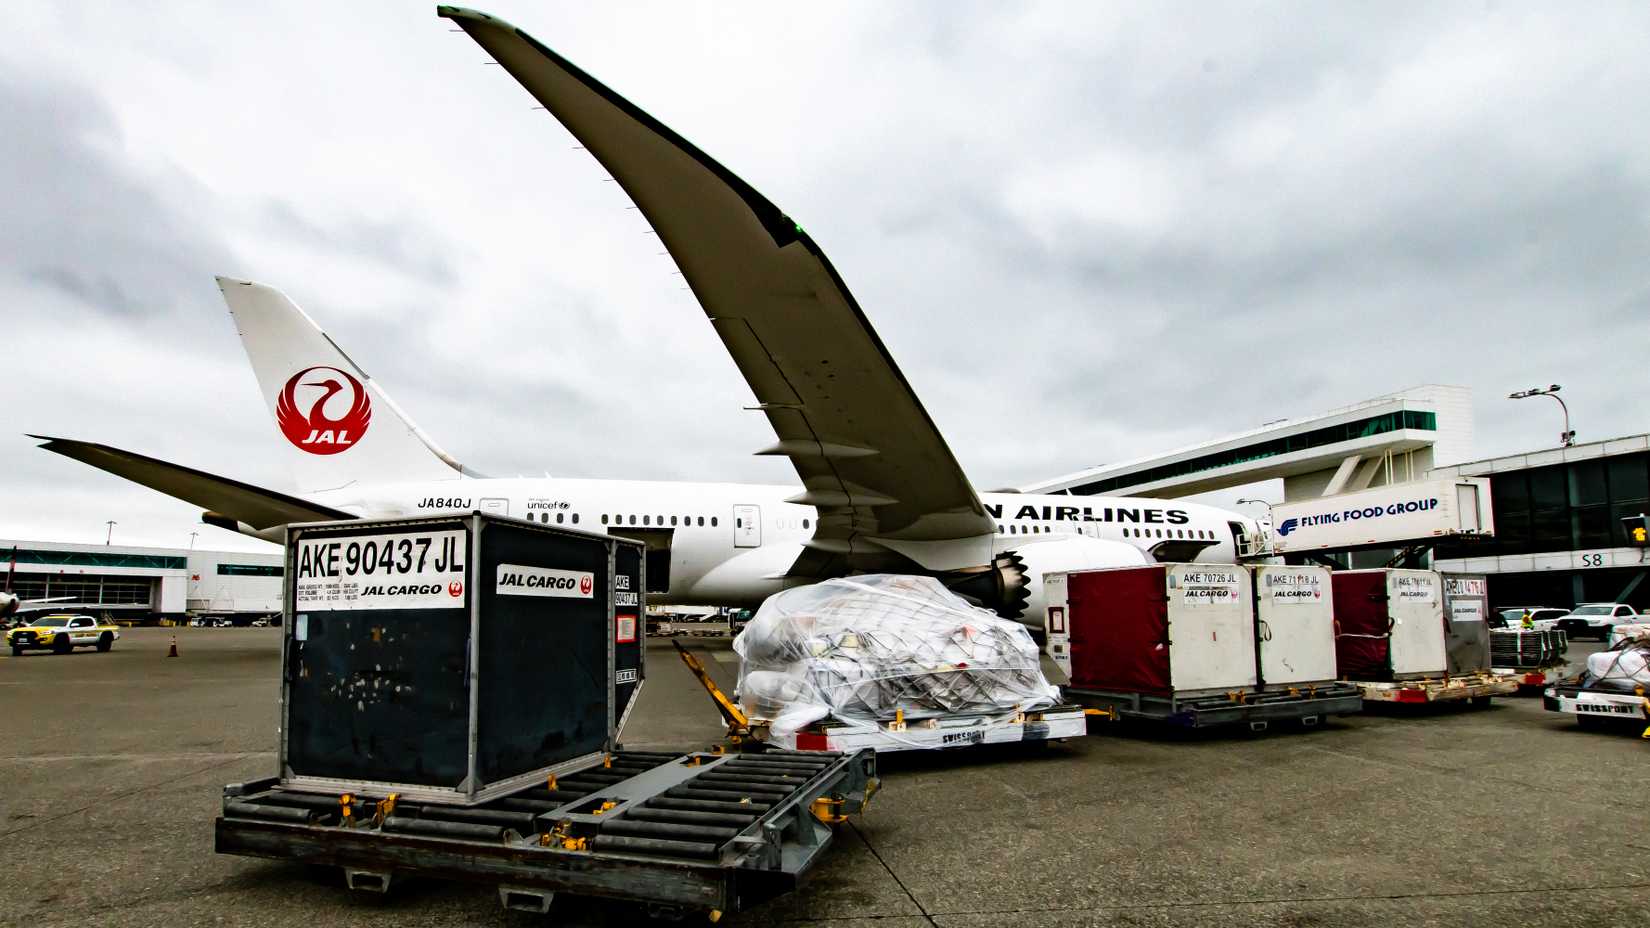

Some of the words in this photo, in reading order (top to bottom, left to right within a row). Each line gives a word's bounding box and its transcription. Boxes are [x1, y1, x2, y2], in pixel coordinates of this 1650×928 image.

[301, 429, 352, 444] JAL
[417, 497, 472, 509] JA840J
[527, 500, 559, 510] unicef
[1014, 505, 1190, 525] AIRLINES
[1301, 512, 1341, 527] FLYING
[1343, 507, 1384, 522] FOOD
[1386, 498, 1439, 516] GROUP
[299, 542, 342, 579] AKE
[345, 537, 433, 576] 90437
[434, 536, 465, 574] JL
[1582, 553, 1603, 568] S8
[616, 576, 629, 588] AKE
[1183, 573, 1201, 583] AKE
[1203, 573, 1226, 583] 70726
[1227, 573, 1237, 583] JL
[1272, 575, 1287, 584] AKE
[1311, 575, 1319, 584] JL
